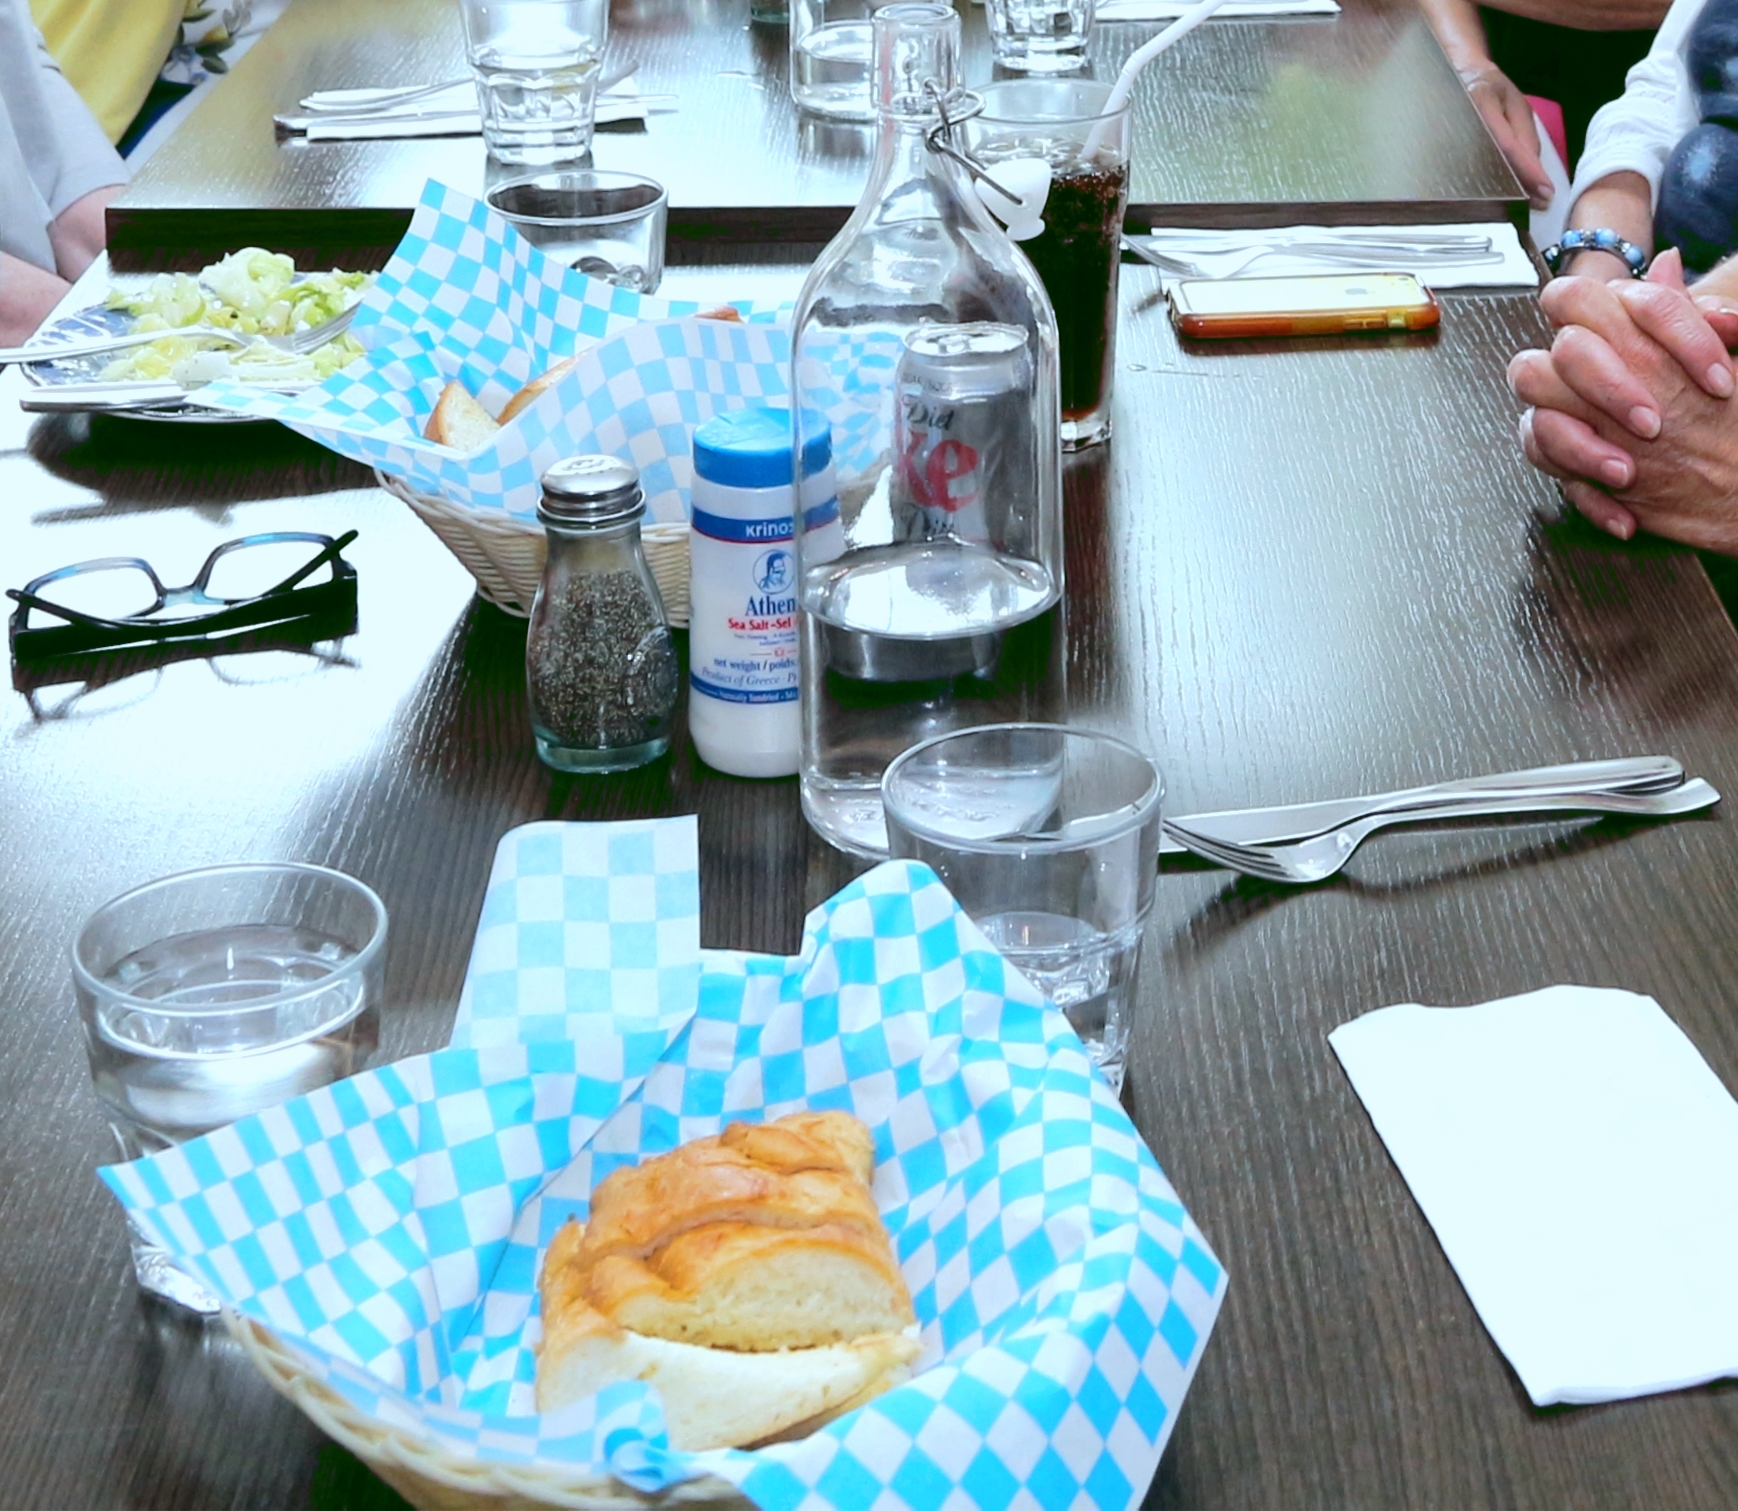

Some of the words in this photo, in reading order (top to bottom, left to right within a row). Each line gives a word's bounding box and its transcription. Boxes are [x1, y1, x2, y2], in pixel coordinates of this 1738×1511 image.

[728, 617, 745, 630] Sea
[714, 658, 727, 668] net
[730, 658, 760, 672] weight
[701, 666, 731, 683] Product
[734, 674, 745, 686] of
[746, 673, 781, 686] Greece
